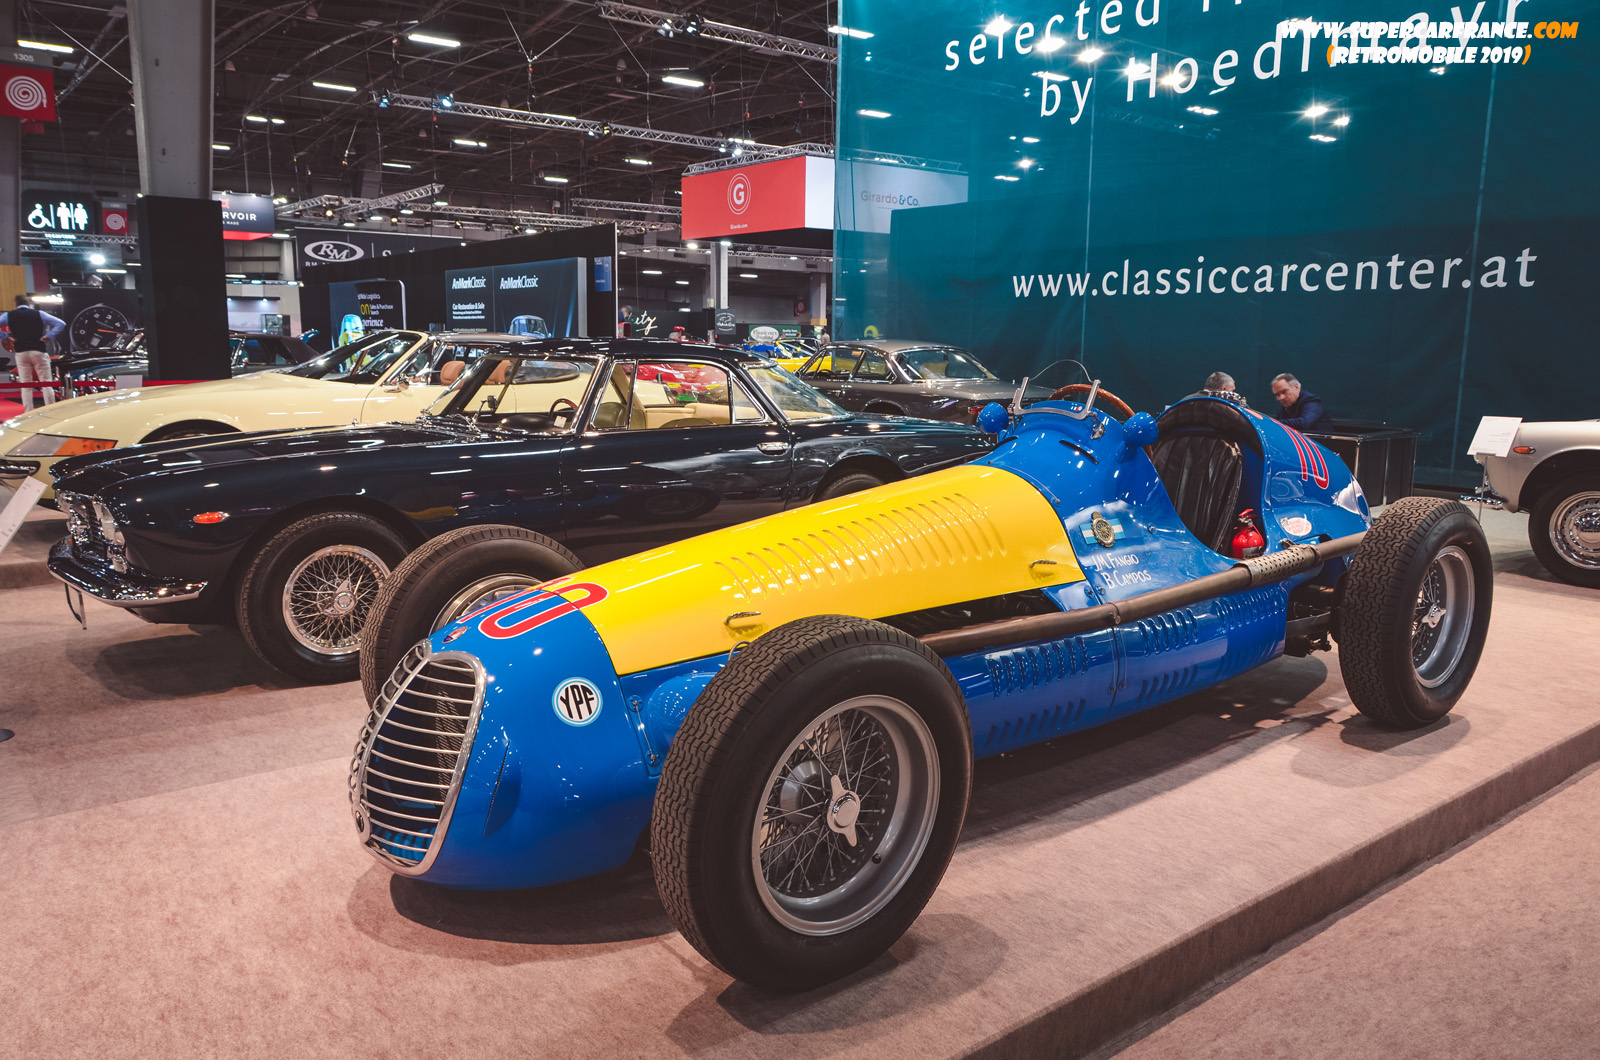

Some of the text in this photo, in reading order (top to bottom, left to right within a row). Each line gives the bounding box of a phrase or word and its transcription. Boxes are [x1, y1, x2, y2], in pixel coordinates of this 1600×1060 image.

[13, 53, 35, 62] 1305
[1040, 73, 1093, 124] by
[733, 183, 745, 205] G
[318, 243, 350, 260] RM
[1013, 247, 1537, 298] www.classiccarcenter.at
[1106, 552, 1140, 569] FANGIO
[1112, 569, 1152, 587] CAMPOS
[559, 684, 595, 720] YPF
